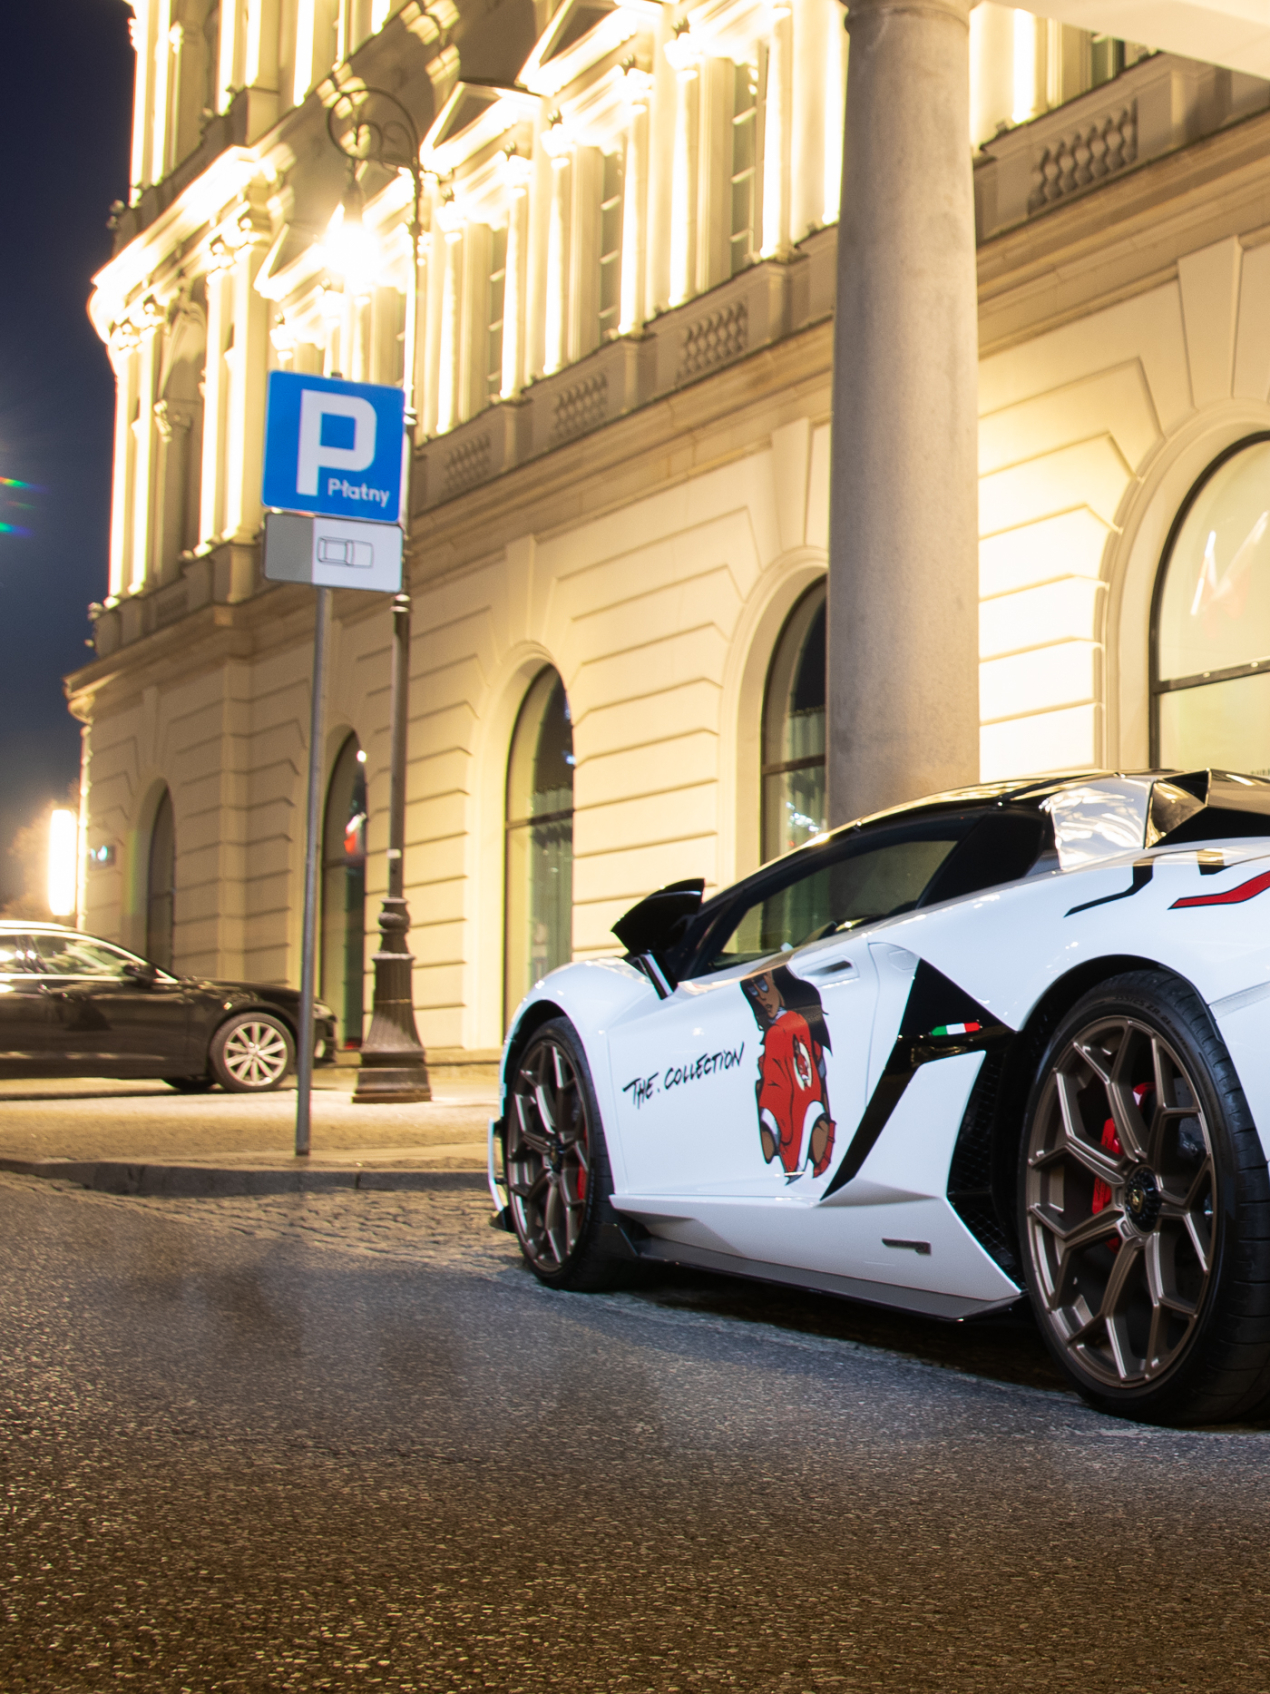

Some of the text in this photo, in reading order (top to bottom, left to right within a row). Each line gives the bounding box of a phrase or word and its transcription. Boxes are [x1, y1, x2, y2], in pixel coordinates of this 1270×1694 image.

[296, 389, 377, 496] P
[327, 478, 390, 508] Płatny
[664, 1041, 745, 1090] COLLECTION
